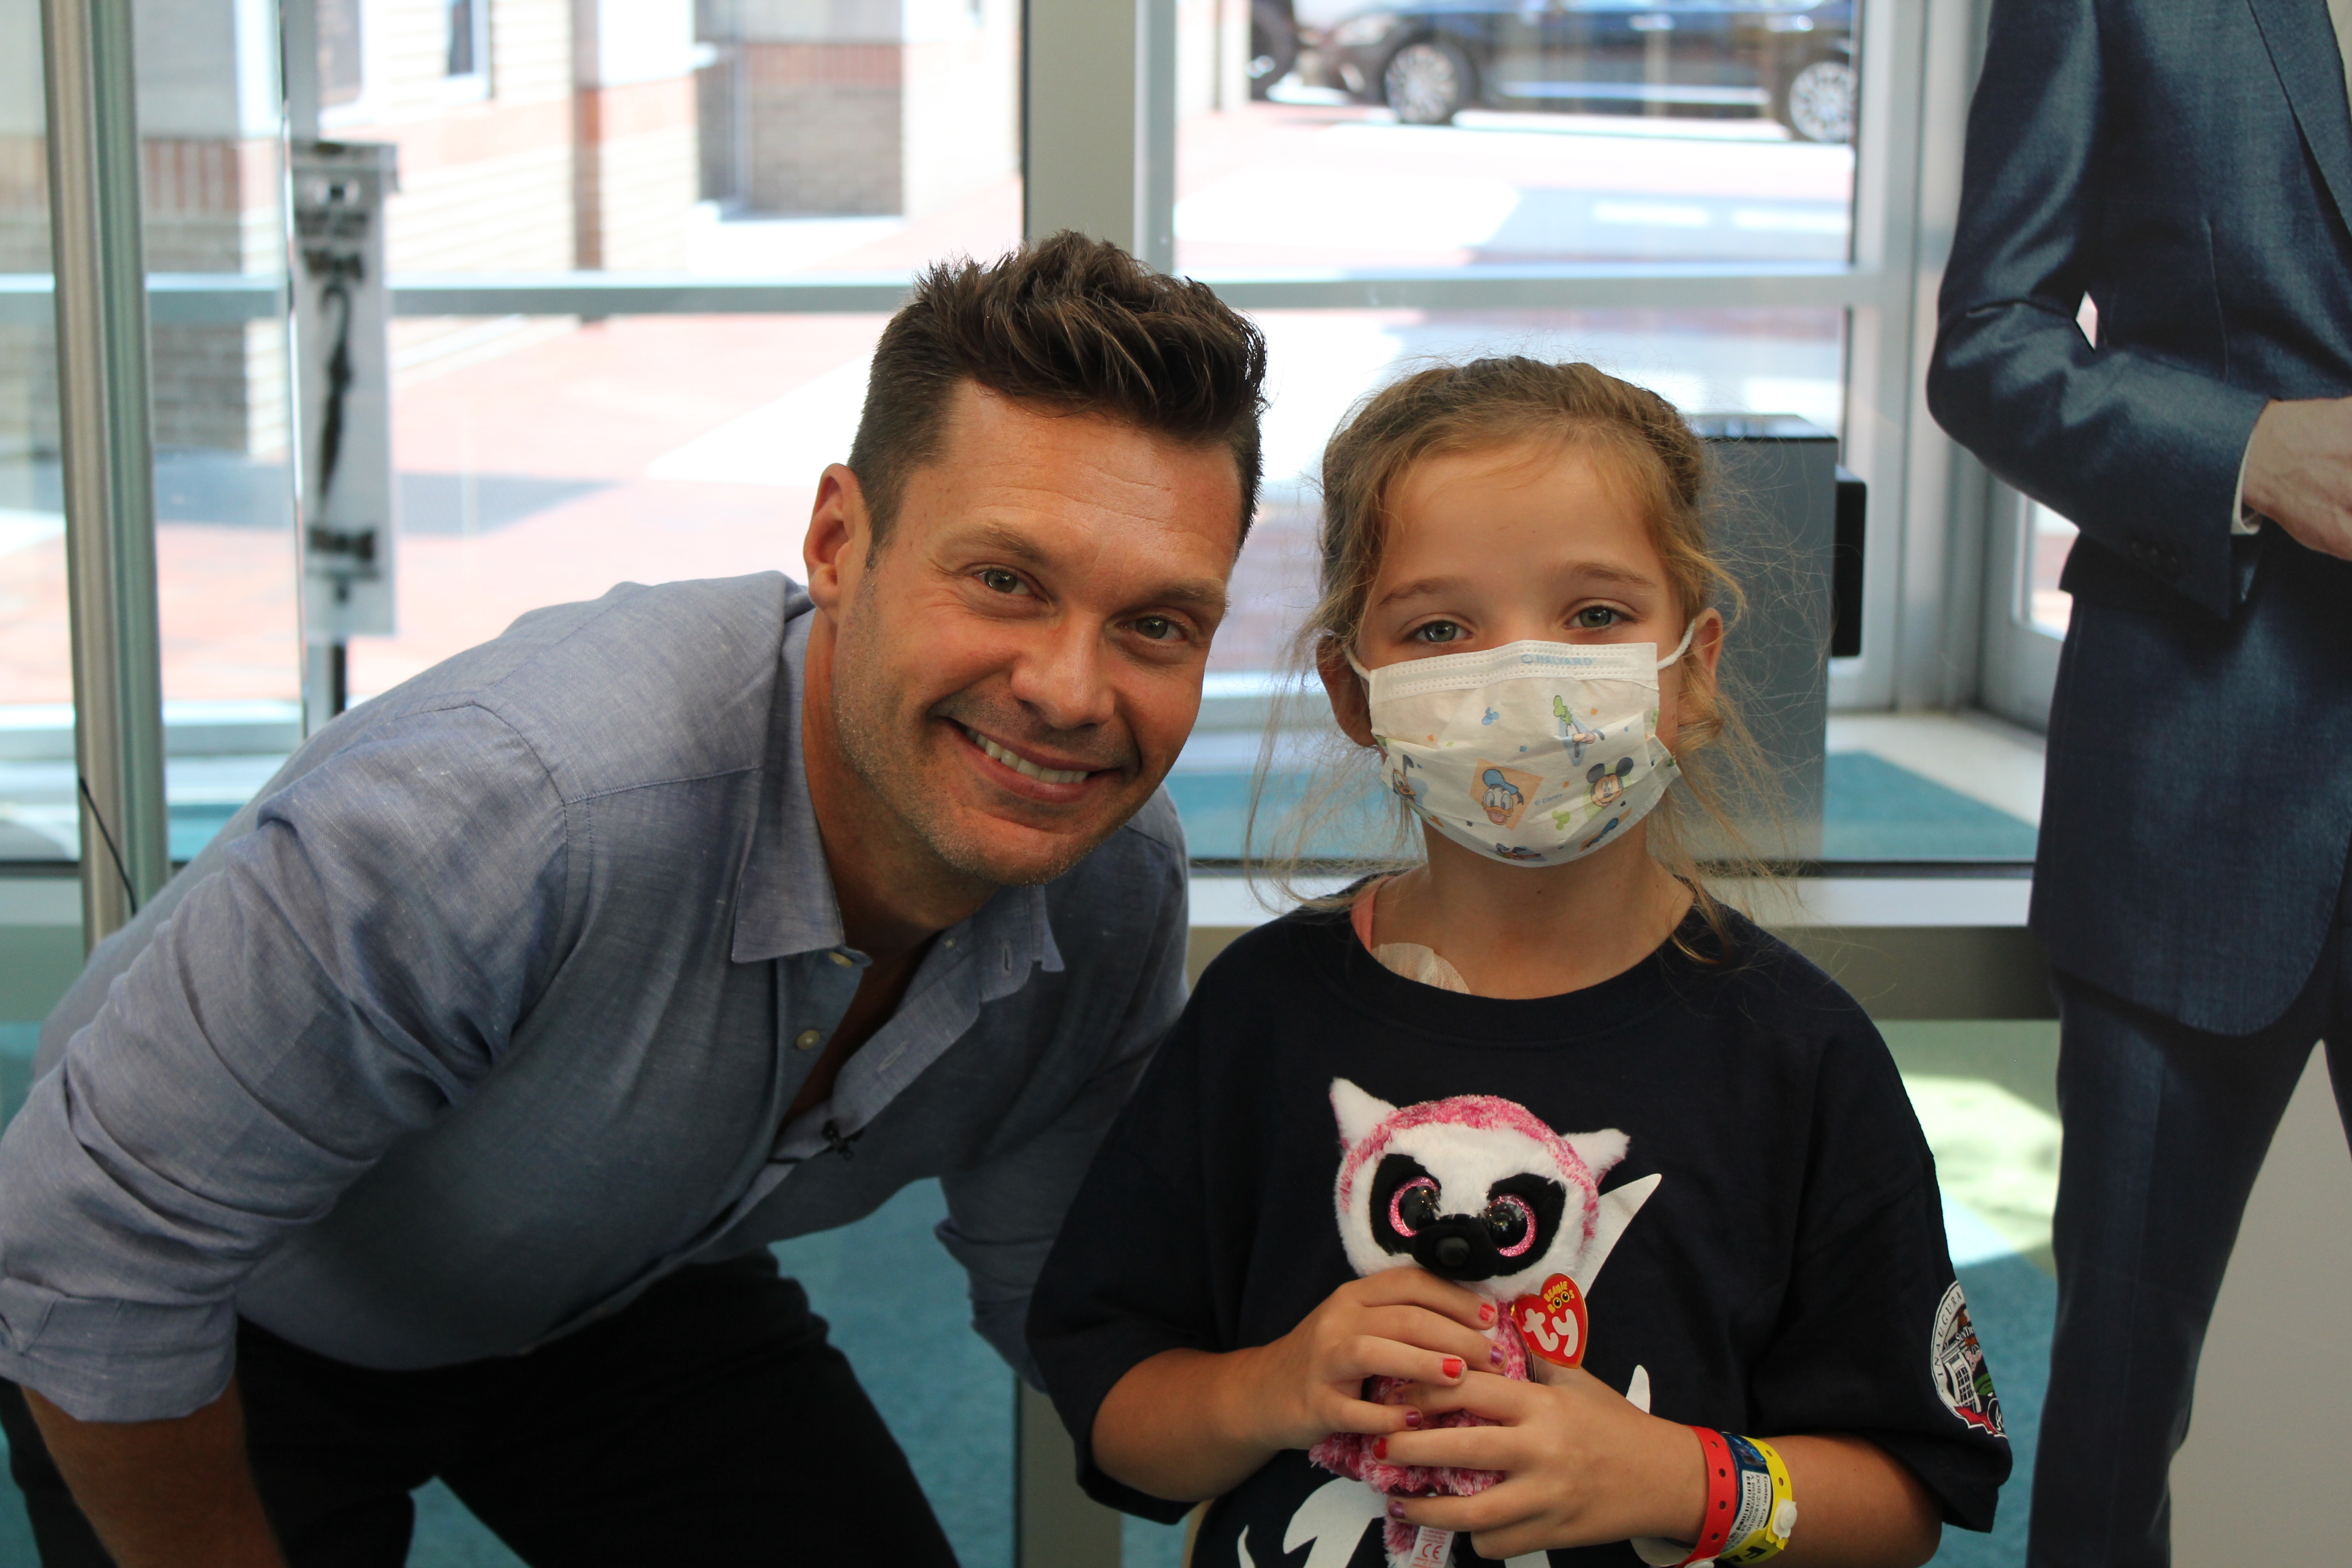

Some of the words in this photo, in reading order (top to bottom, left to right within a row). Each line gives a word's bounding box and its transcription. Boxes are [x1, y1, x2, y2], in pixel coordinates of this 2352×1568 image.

[1544, 1281, 1568, 1302] BEANIE
[1547, 1289, 1575, 1313] BOOS
[1523, 1308, 1579, 1357] ty
[1422, 1543, 1443, 1560] CE
